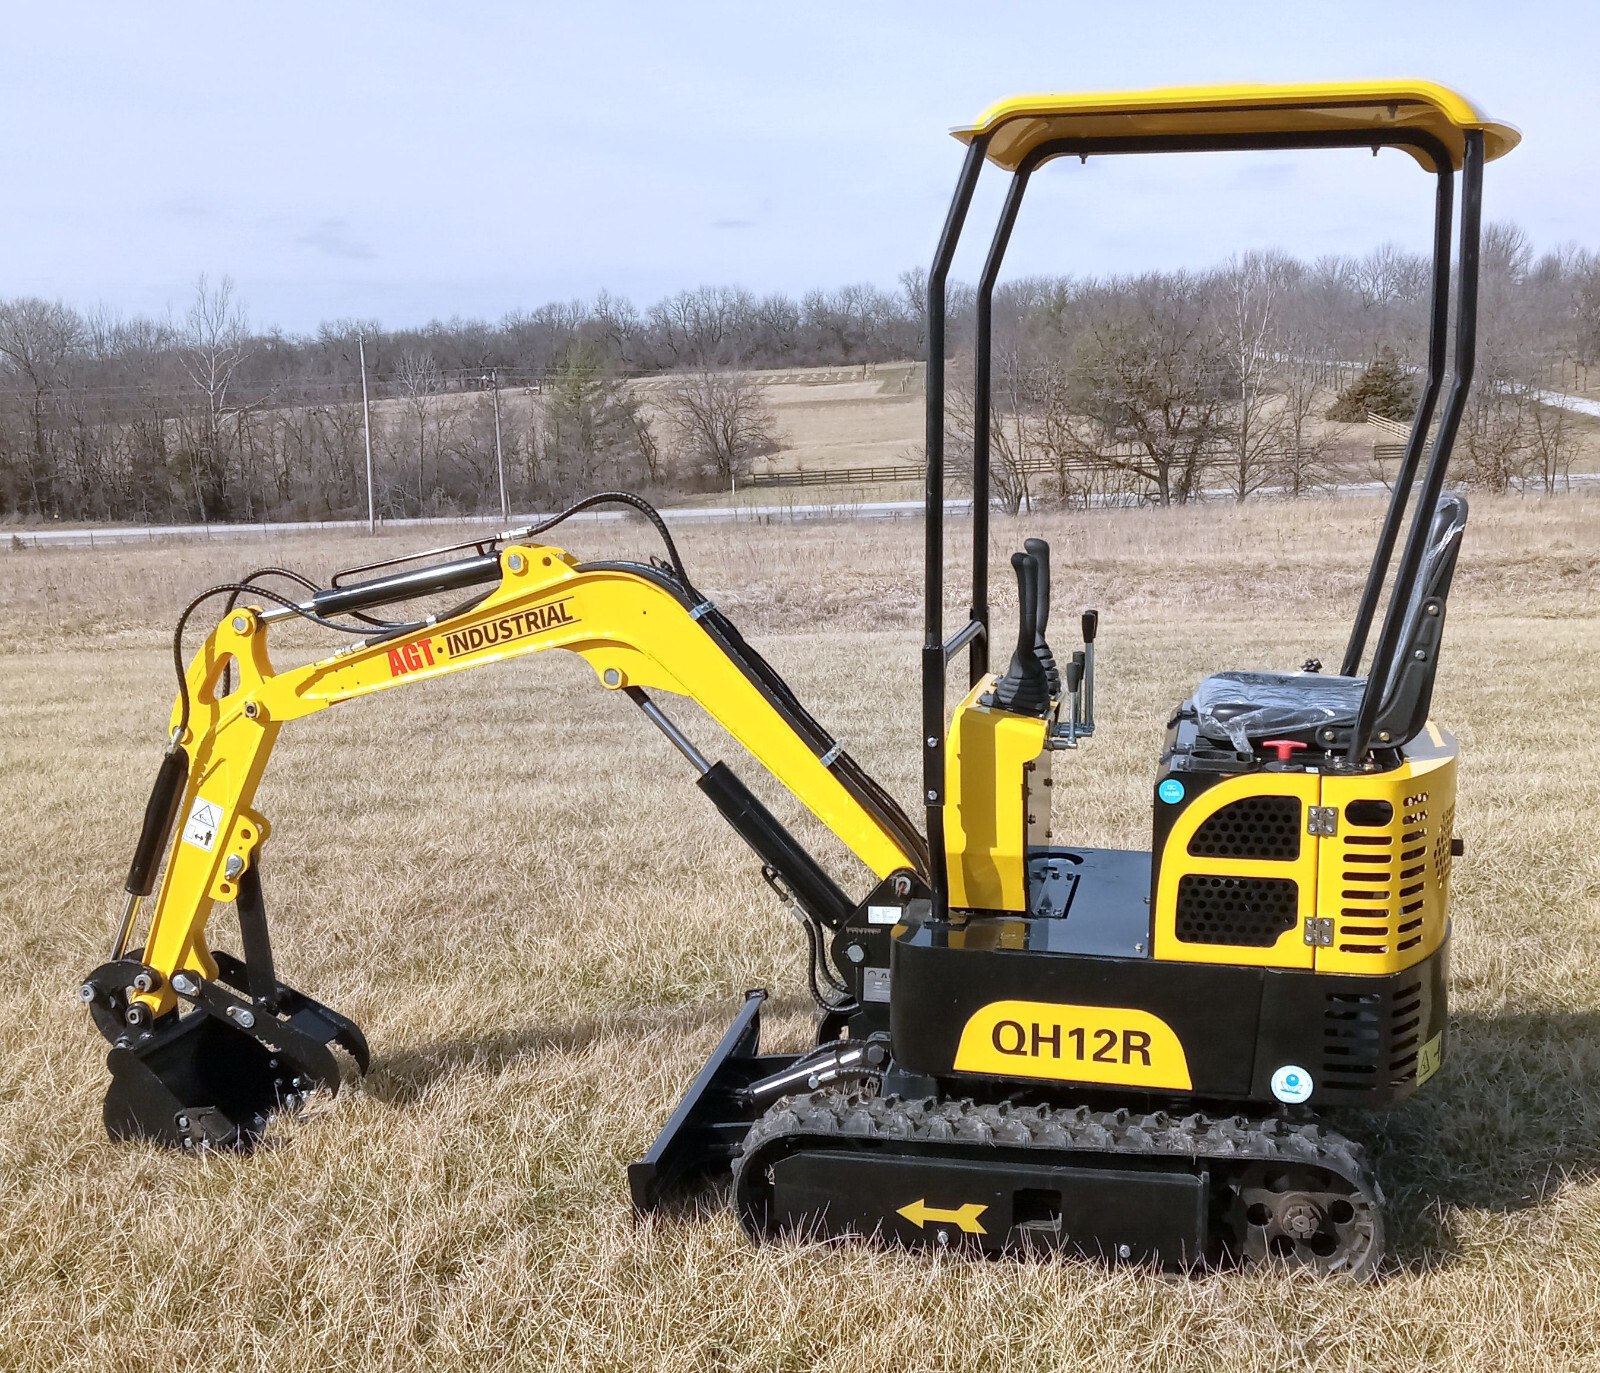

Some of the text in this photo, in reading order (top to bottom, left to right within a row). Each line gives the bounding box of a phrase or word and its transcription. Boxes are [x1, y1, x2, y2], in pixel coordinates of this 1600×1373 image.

[386, 602, 573, 677] AGT INDUSTRIAL
[991, 1019, 1152, 1067] QH12R
